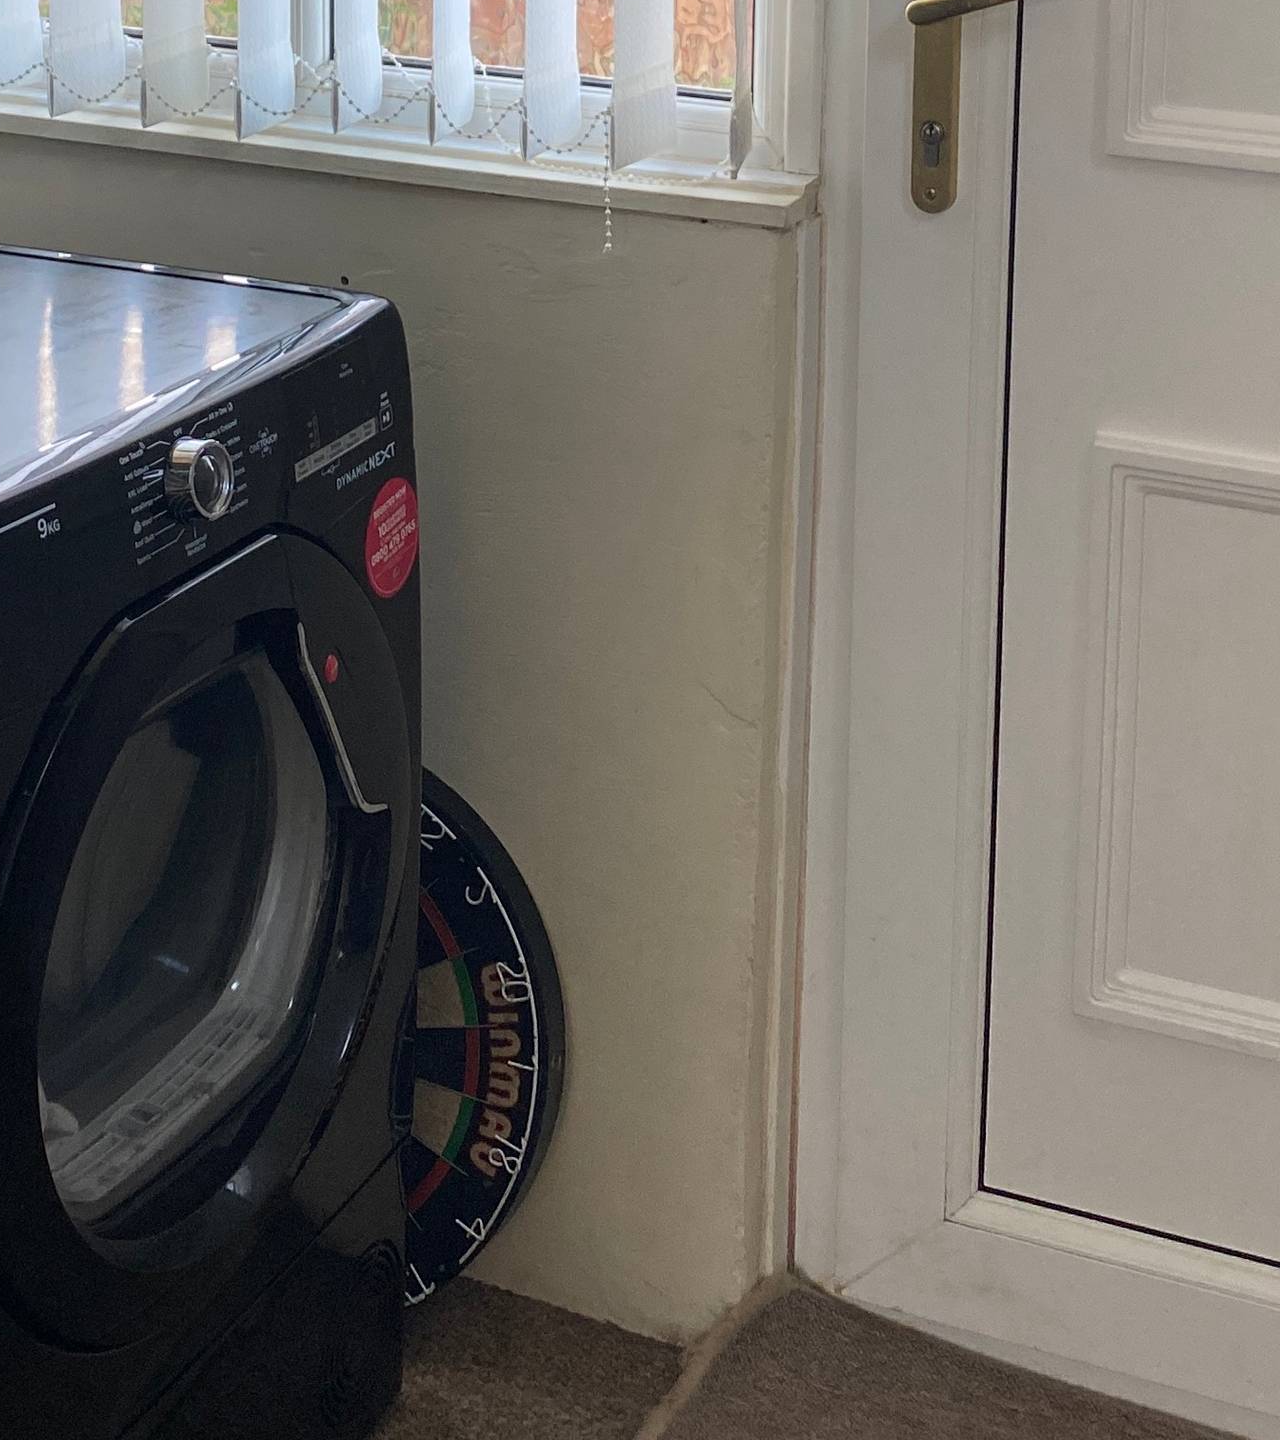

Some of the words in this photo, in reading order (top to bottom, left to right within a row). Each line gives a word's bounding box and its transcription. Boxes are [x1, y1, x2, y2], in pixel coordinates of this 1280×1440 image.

[495, 957, 532, 1003] 20
[488, 1133, 526, 1175] 18
[456, 1217, 486, 1241] 4
